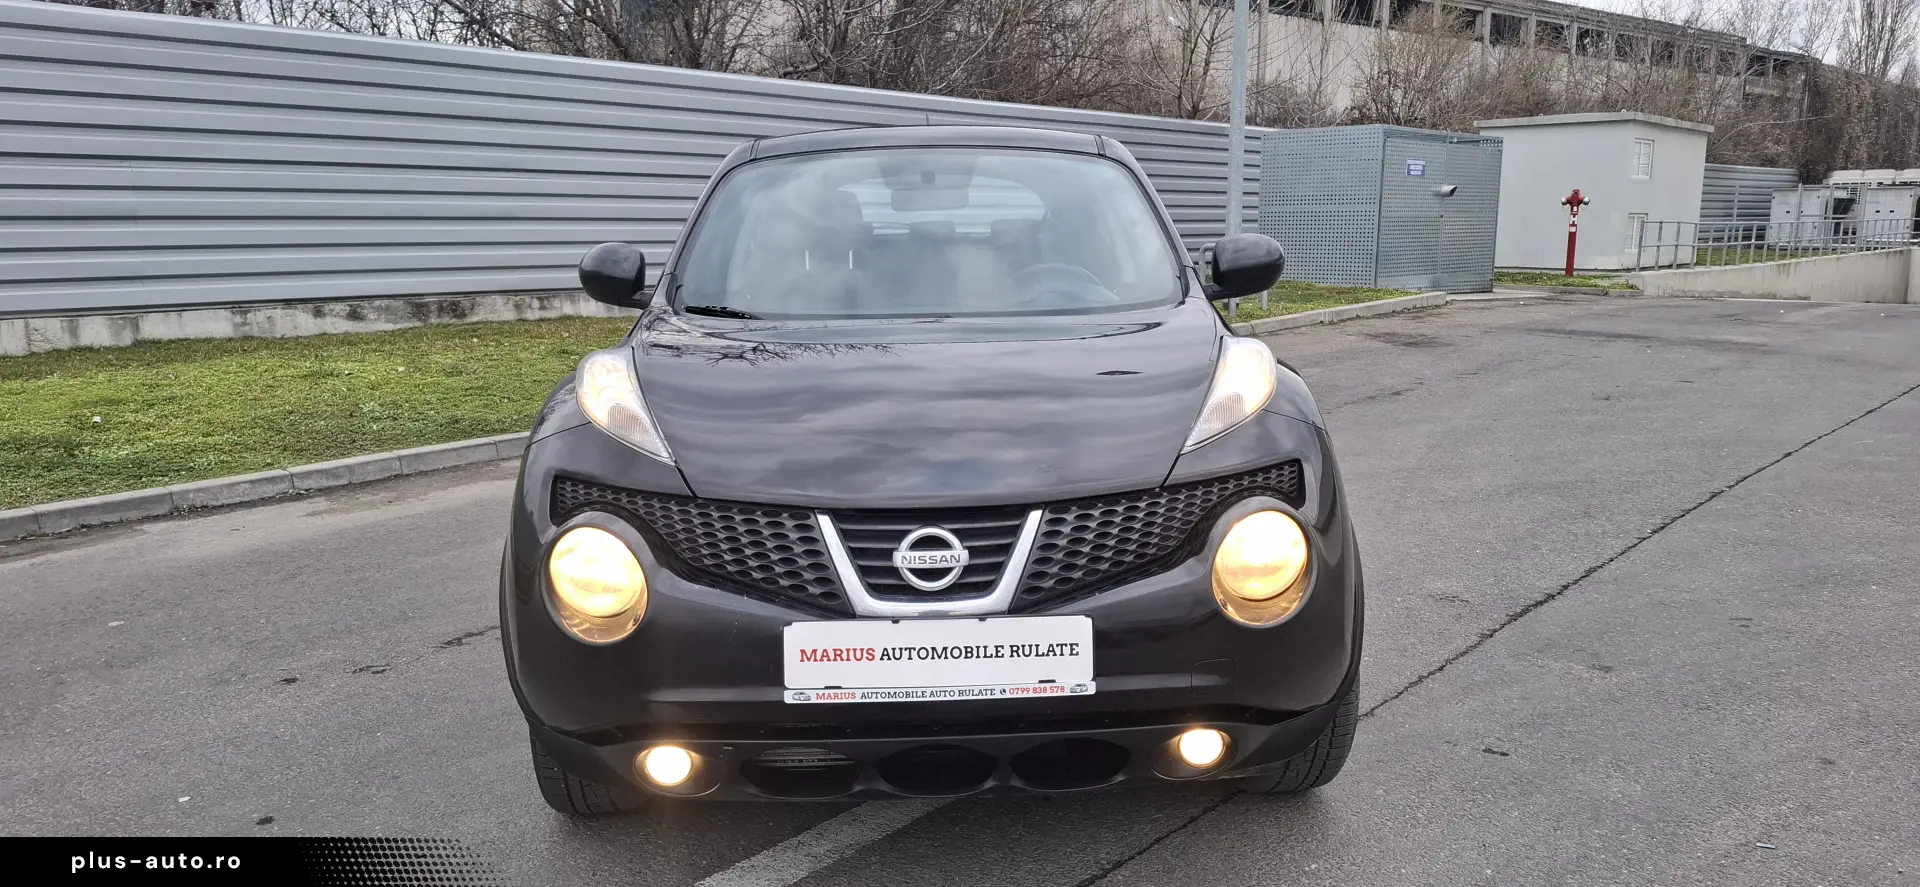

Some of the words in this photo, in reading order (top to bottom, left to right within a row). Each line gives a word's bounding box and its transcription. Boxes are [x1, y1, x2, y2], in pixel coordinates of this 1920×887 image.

[901, 554, 961, 565] NISSAN
[799, 647, 876, 663] MARIUS
[879, 645, 1005, 661] AUTOMOBILE
[1008, 642, 1080, 658] RULATE
[815, 691, 857, 701] MARIUS
[860, 690, 928, 700] AUTOMOBILE
[928, 689, 957, 698] AUTO
[957, 688, 996, 697] RULATE
[1008, 686, 1031, 696] 0799
[1032, 686, 1048, 695] 838
[1049, 685, 1066, 694] 578
